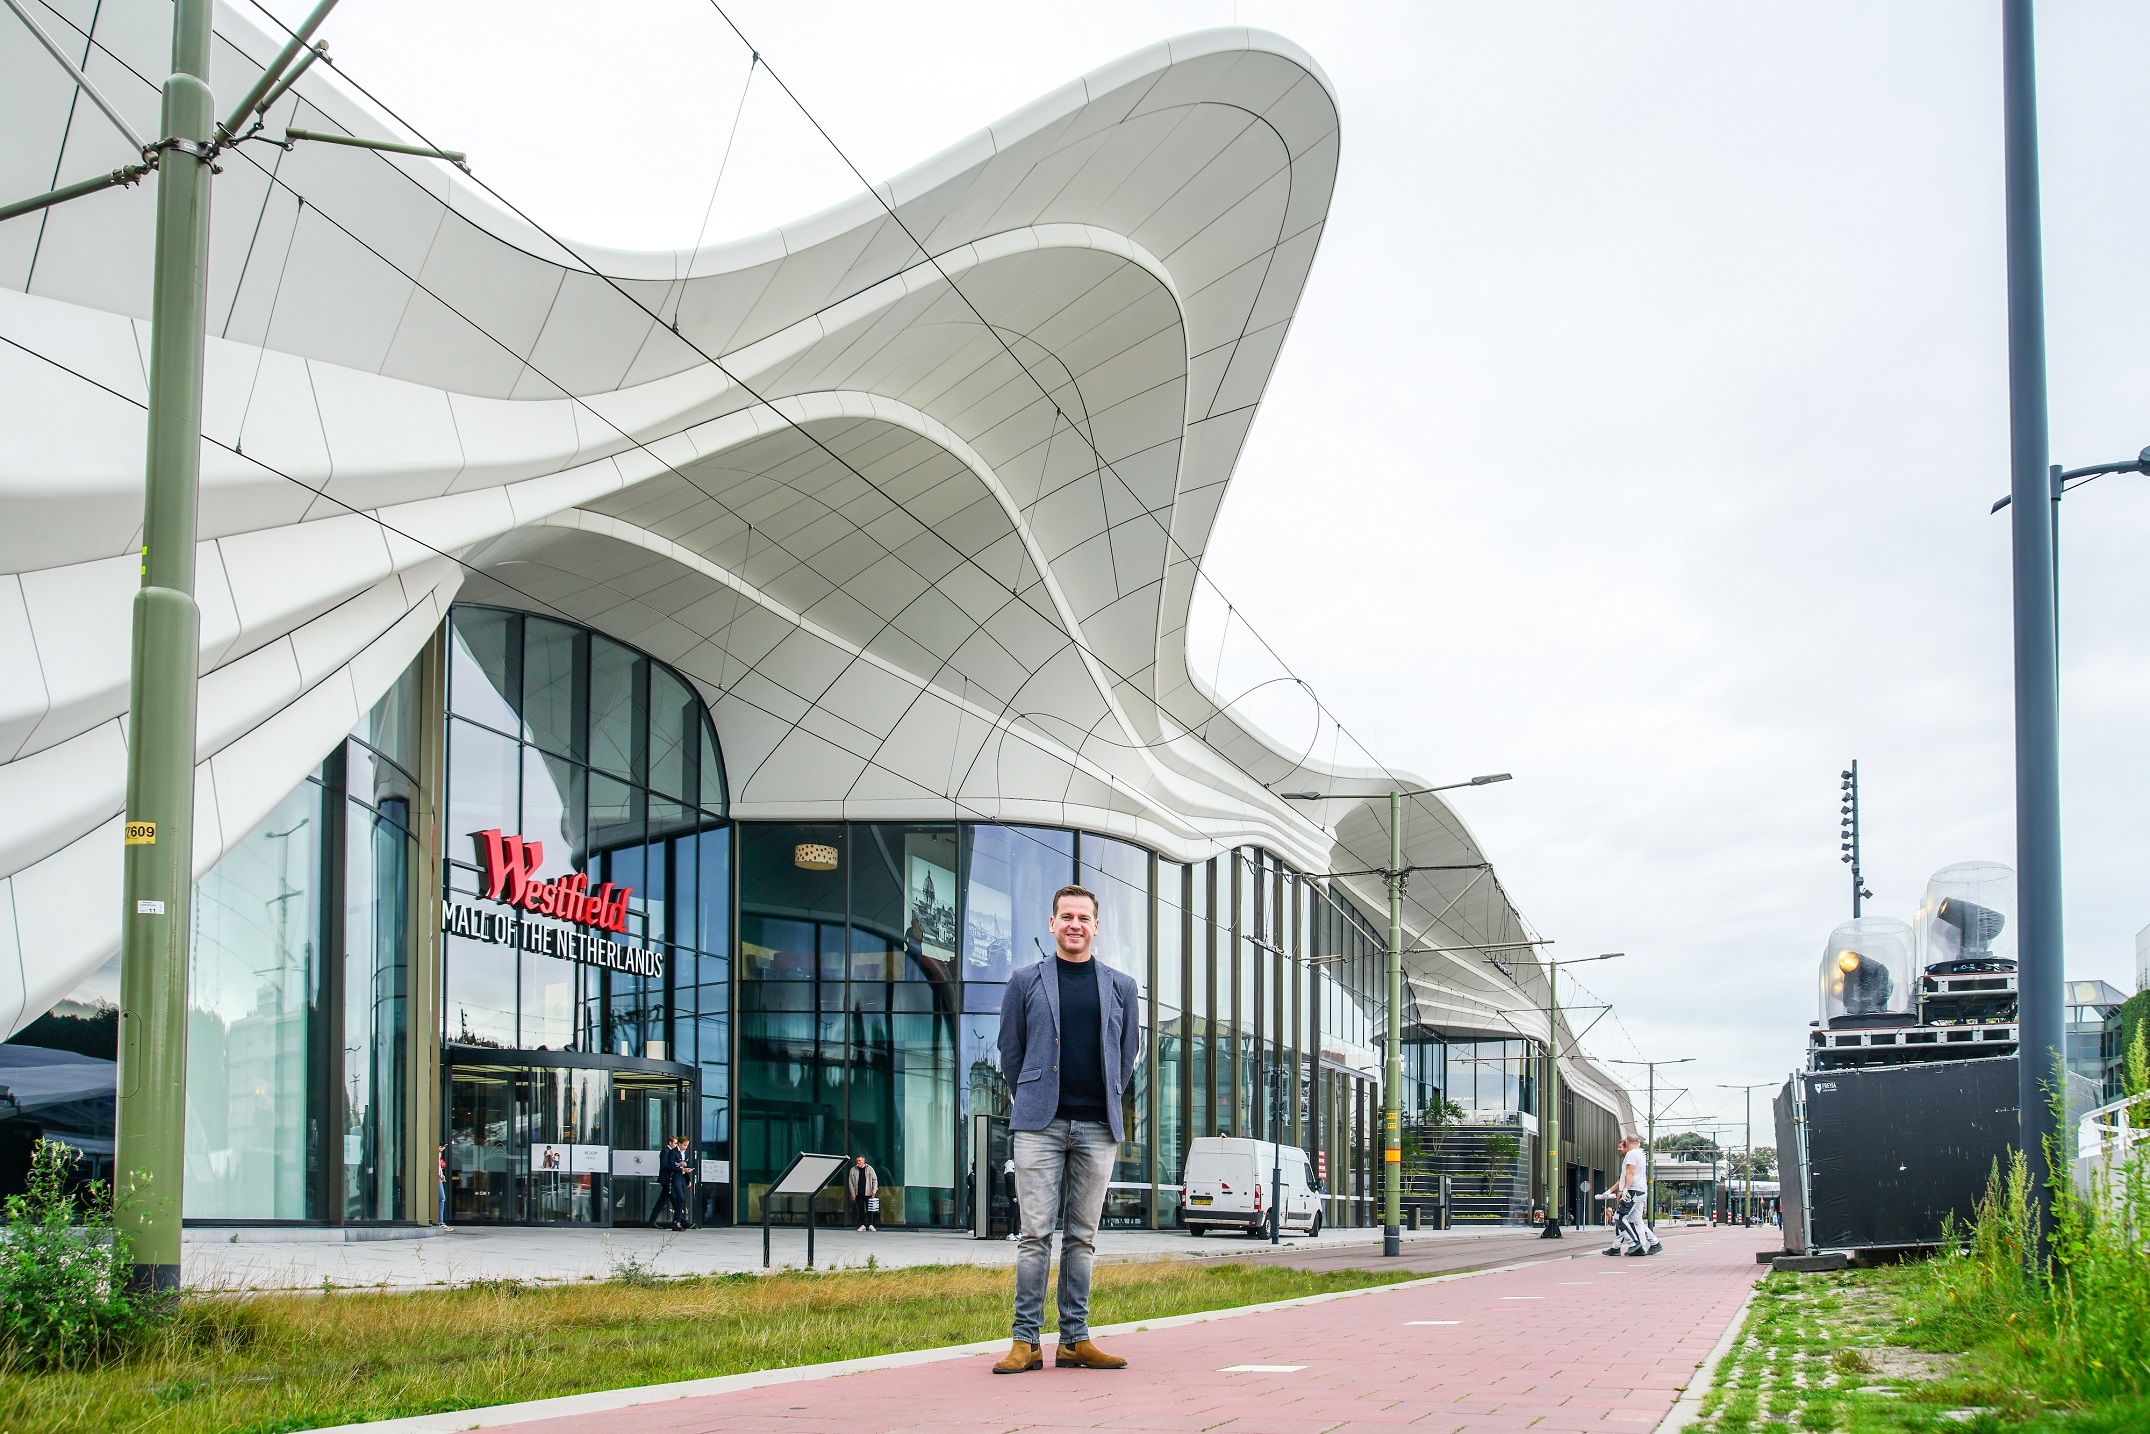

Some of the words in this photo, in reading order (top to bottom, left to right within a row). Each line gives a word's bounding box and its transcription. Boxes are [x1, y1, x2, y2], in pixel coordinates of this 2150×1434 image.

[477, 828, 634, 933] Westfield
[441, 899, 489, 939] MALL
[494, 913, 518, 944] OF
[521, 920, 552, 953] THE
[556, 930, 664, 978] NETHERLANDS
